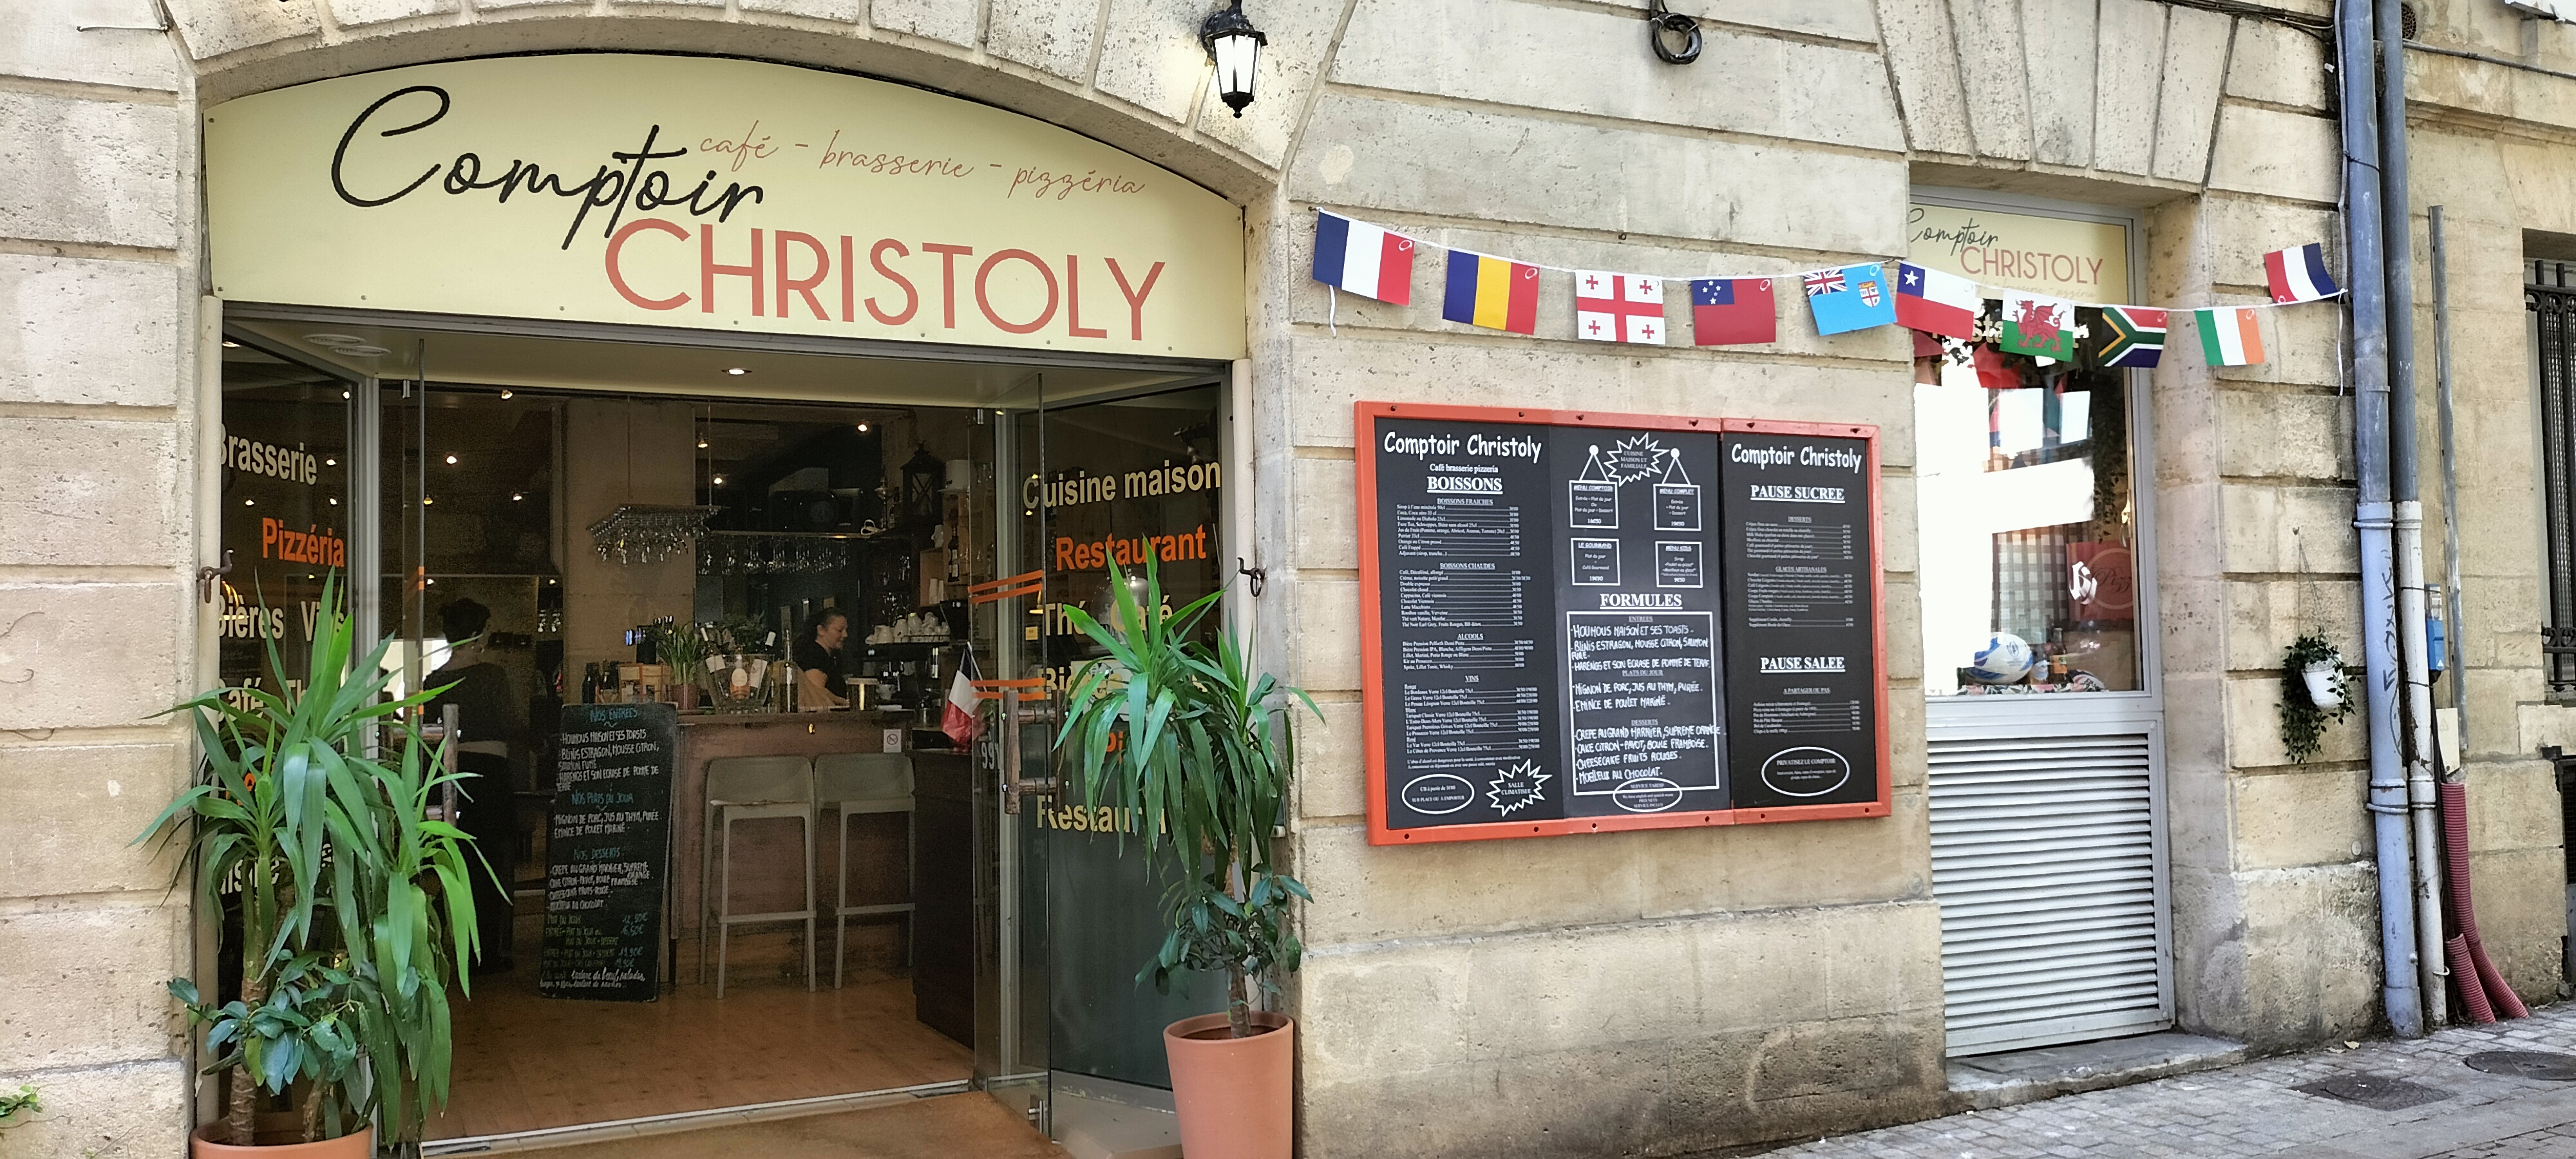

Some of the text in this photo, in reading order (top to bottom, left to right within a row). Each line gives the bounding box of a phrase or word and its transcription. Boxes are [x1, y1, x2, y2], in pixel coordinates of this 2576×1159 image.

[699, 120, 1145, 198] café brasserie pizzéria
[332, 85, 763, 251] Comptoir
[1961, 246, 2103, 285] CHRISTOLY
[605, 216, 1166, 341] CHRISTOLY
[1384, 431, 1542, 464] Comptoir Christoly
[1732, 444, 1862, 474] Comptoir Christoly
[1446, 464, 1473, 473] brasserie
[1023, 460, 1220, 509] Cuisine maison
[1427, 476, 1502, 491] BOISSONS
[1750, 485, 1844, 500] PAUSE SUCREE
[262, 518, 344, 567] Pizzéria
[1600, 594, 1682, 607] FORMULES
[1614, 624, 1639, 637] MAISON
[1640, 626, 1649, 636] ET
[1650, 625, 1663, 635] SES
[1596, 640, 1634, 651] ESTRAGON,
[1635, 639, 1659, 648] MOUSSE
[1683, 636, 1709, 647] SAUMON
[1575, 661, 1603, 671] HARENGS
[1603, 660, 1611, 670] ET
[1612, 660, 1625, 669] SON
[1652, 659, 1660, 668] DE
[1662, 658, 1683, 667] POMME
[1683, 658, 1691, 666] DE
[1760, 657, 1845, 670] PAUSE SALEE
[1575, 683, 1602, 695] MIGNON
[1603, 683, 1612, 693] DE
[1613, 683, 1631, 694] PORC,
[1632, 683, 1645, 692] JUS
[1647, 683, 1656, 691] AU
[1604, 699, 1613, 709] DE
[1615, 697, 1638, 708] POULET
[1598, 728, 1607, 738] AU
[1607, 726, 1629, 738] GRAND
[1631, 727, 1665, 739] MARNIER,
[1577, 743, 1594, 754] CAKE
[1647, 740, 1667, 750] BOULE
[1577, 755, 1620, 769] CHEESECAKE
[1623, 752, 1648, 763] FRUITS
[1612, 770, 1623, 780] AU
